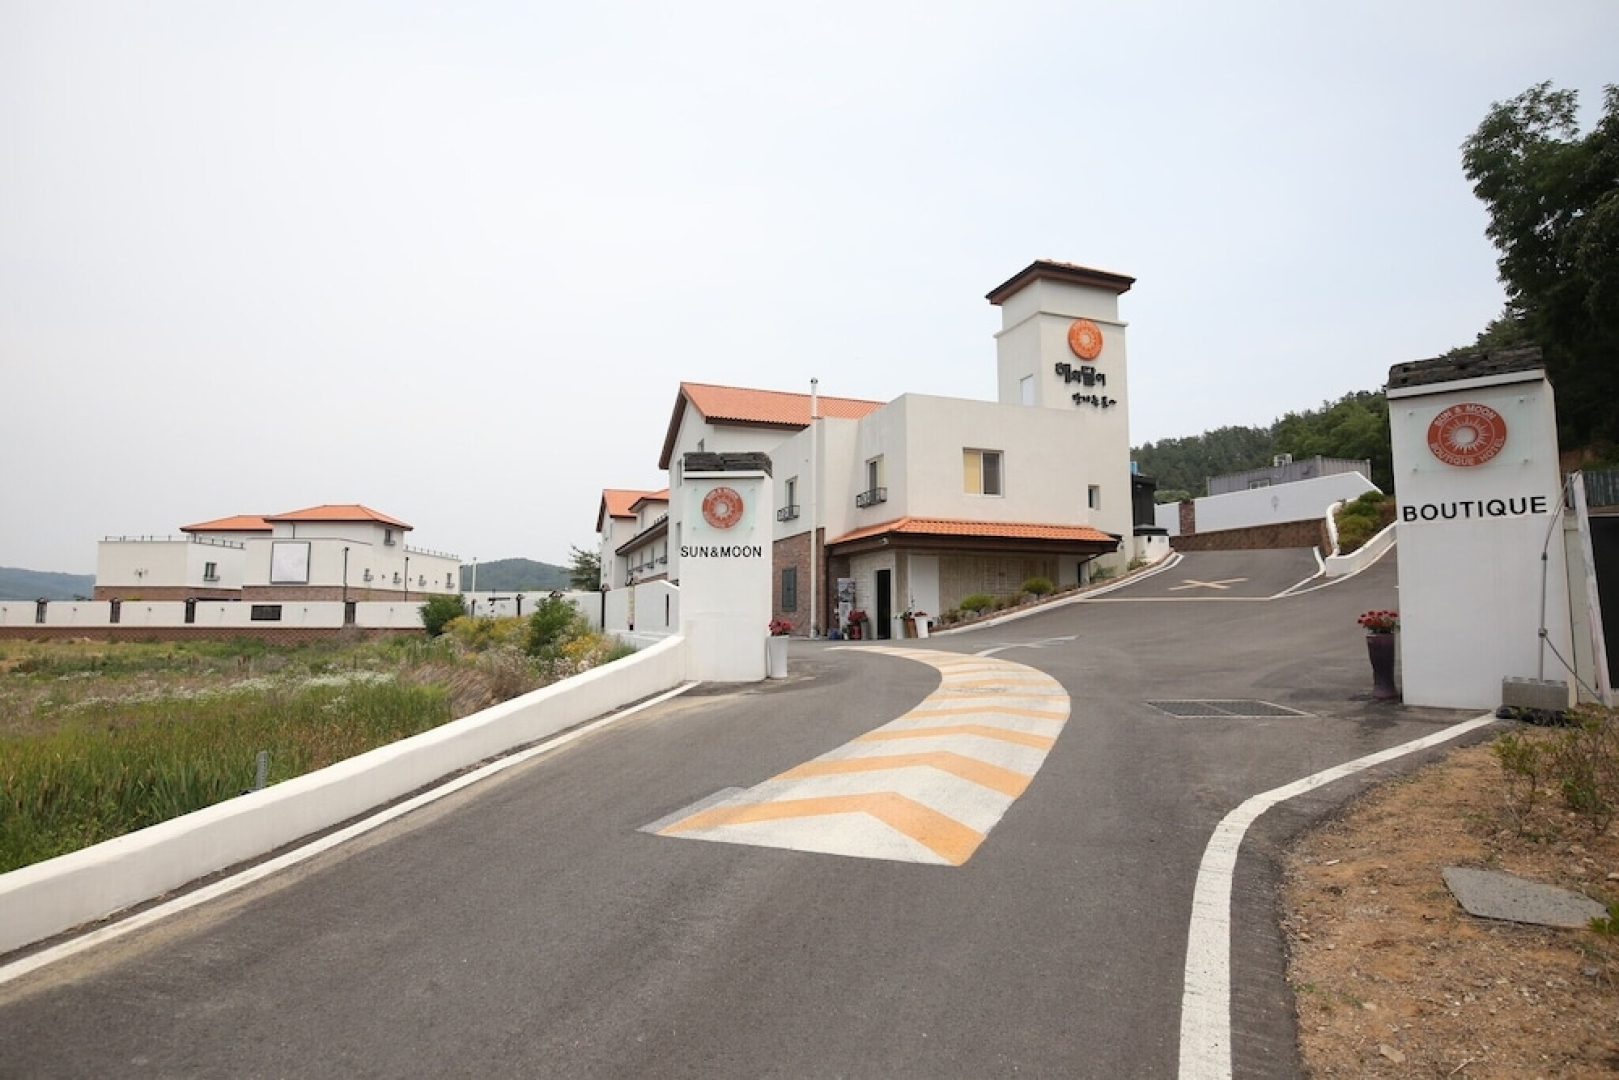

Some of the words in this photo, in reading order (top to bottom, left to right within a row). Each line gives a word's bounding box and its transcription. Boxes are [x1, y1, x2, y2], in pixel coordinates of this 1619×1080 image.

[1433, 410, 1453, 426] SUN
[1465, 404, 1497, 420] MOON
[1430, 442, 1475, 466] BOUTIQUE
[1402, 496, 1547, 522] BOUTIQUE
[680, 545, 762, 558] SUN&MOON
